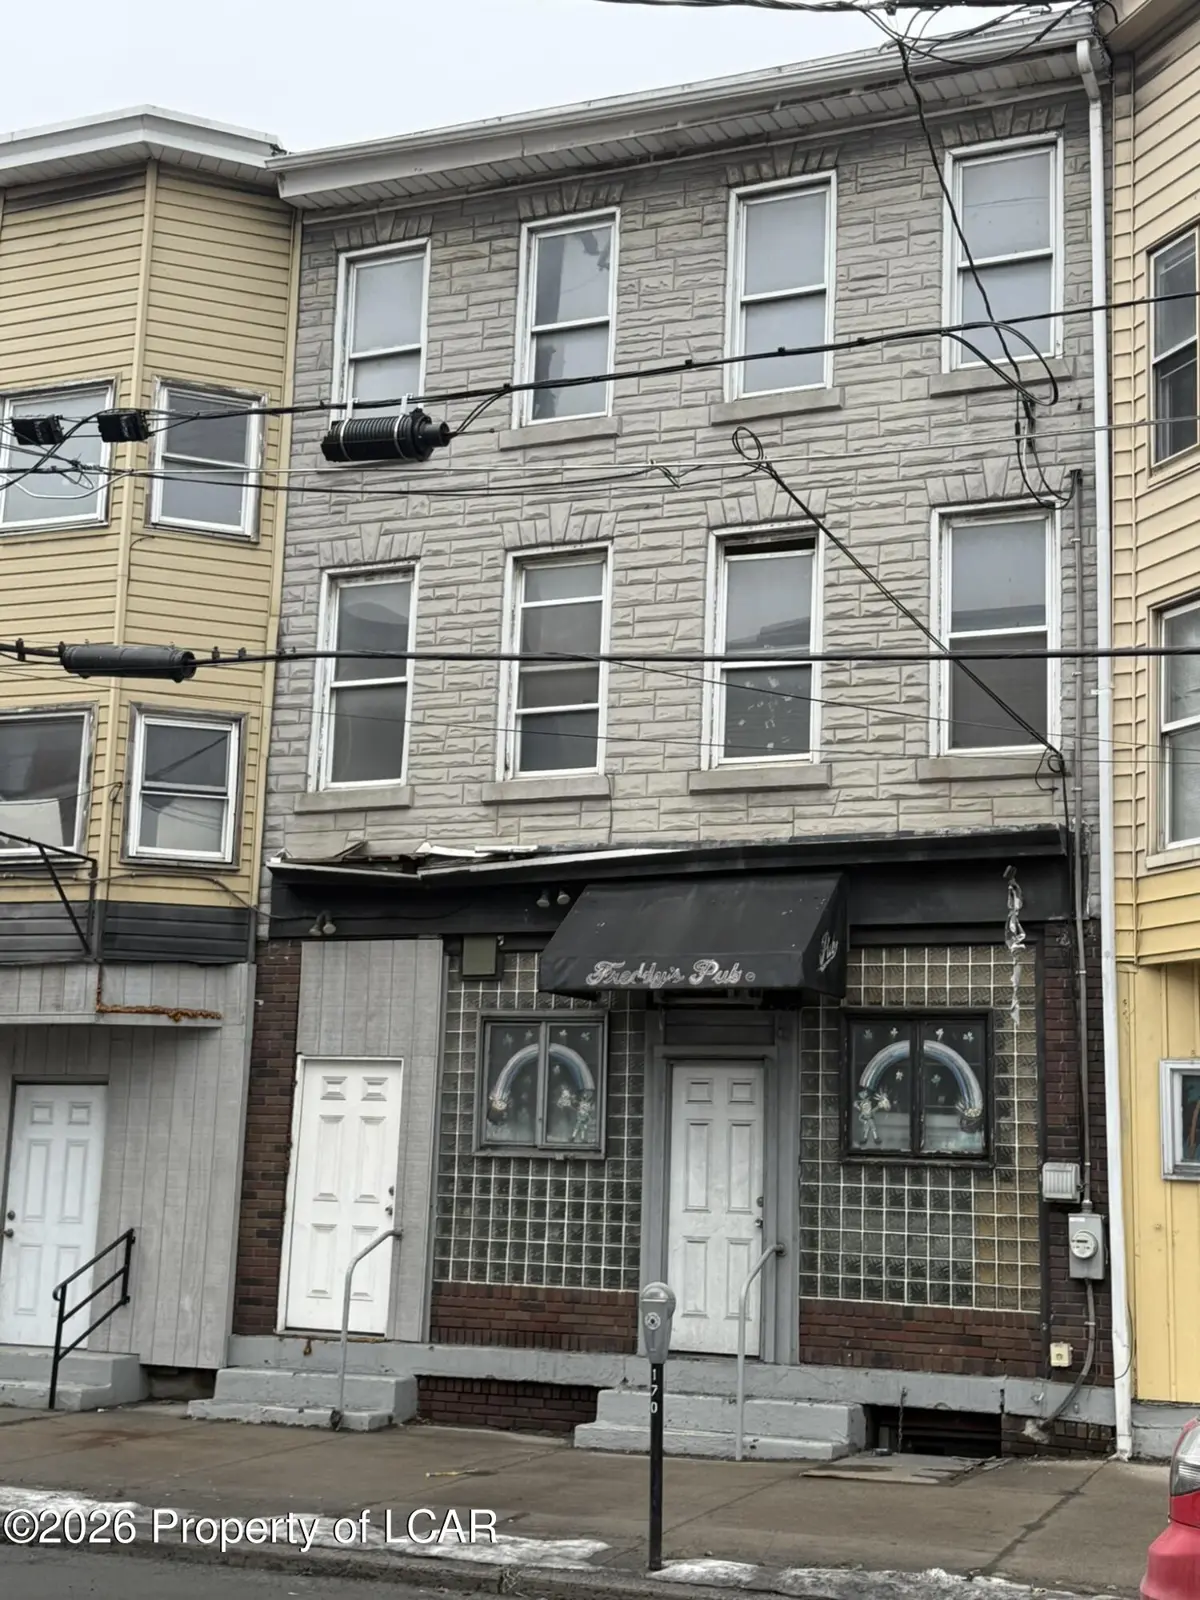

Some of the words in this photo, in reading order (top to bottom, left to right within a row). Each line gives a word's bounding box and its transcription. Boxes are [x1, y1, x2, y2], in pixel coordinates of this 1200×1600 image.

[585, 959, 686, 989] Freddy's
[688, 958, 743, 986] Pub
[650, 1368, 659, 1414] 170
